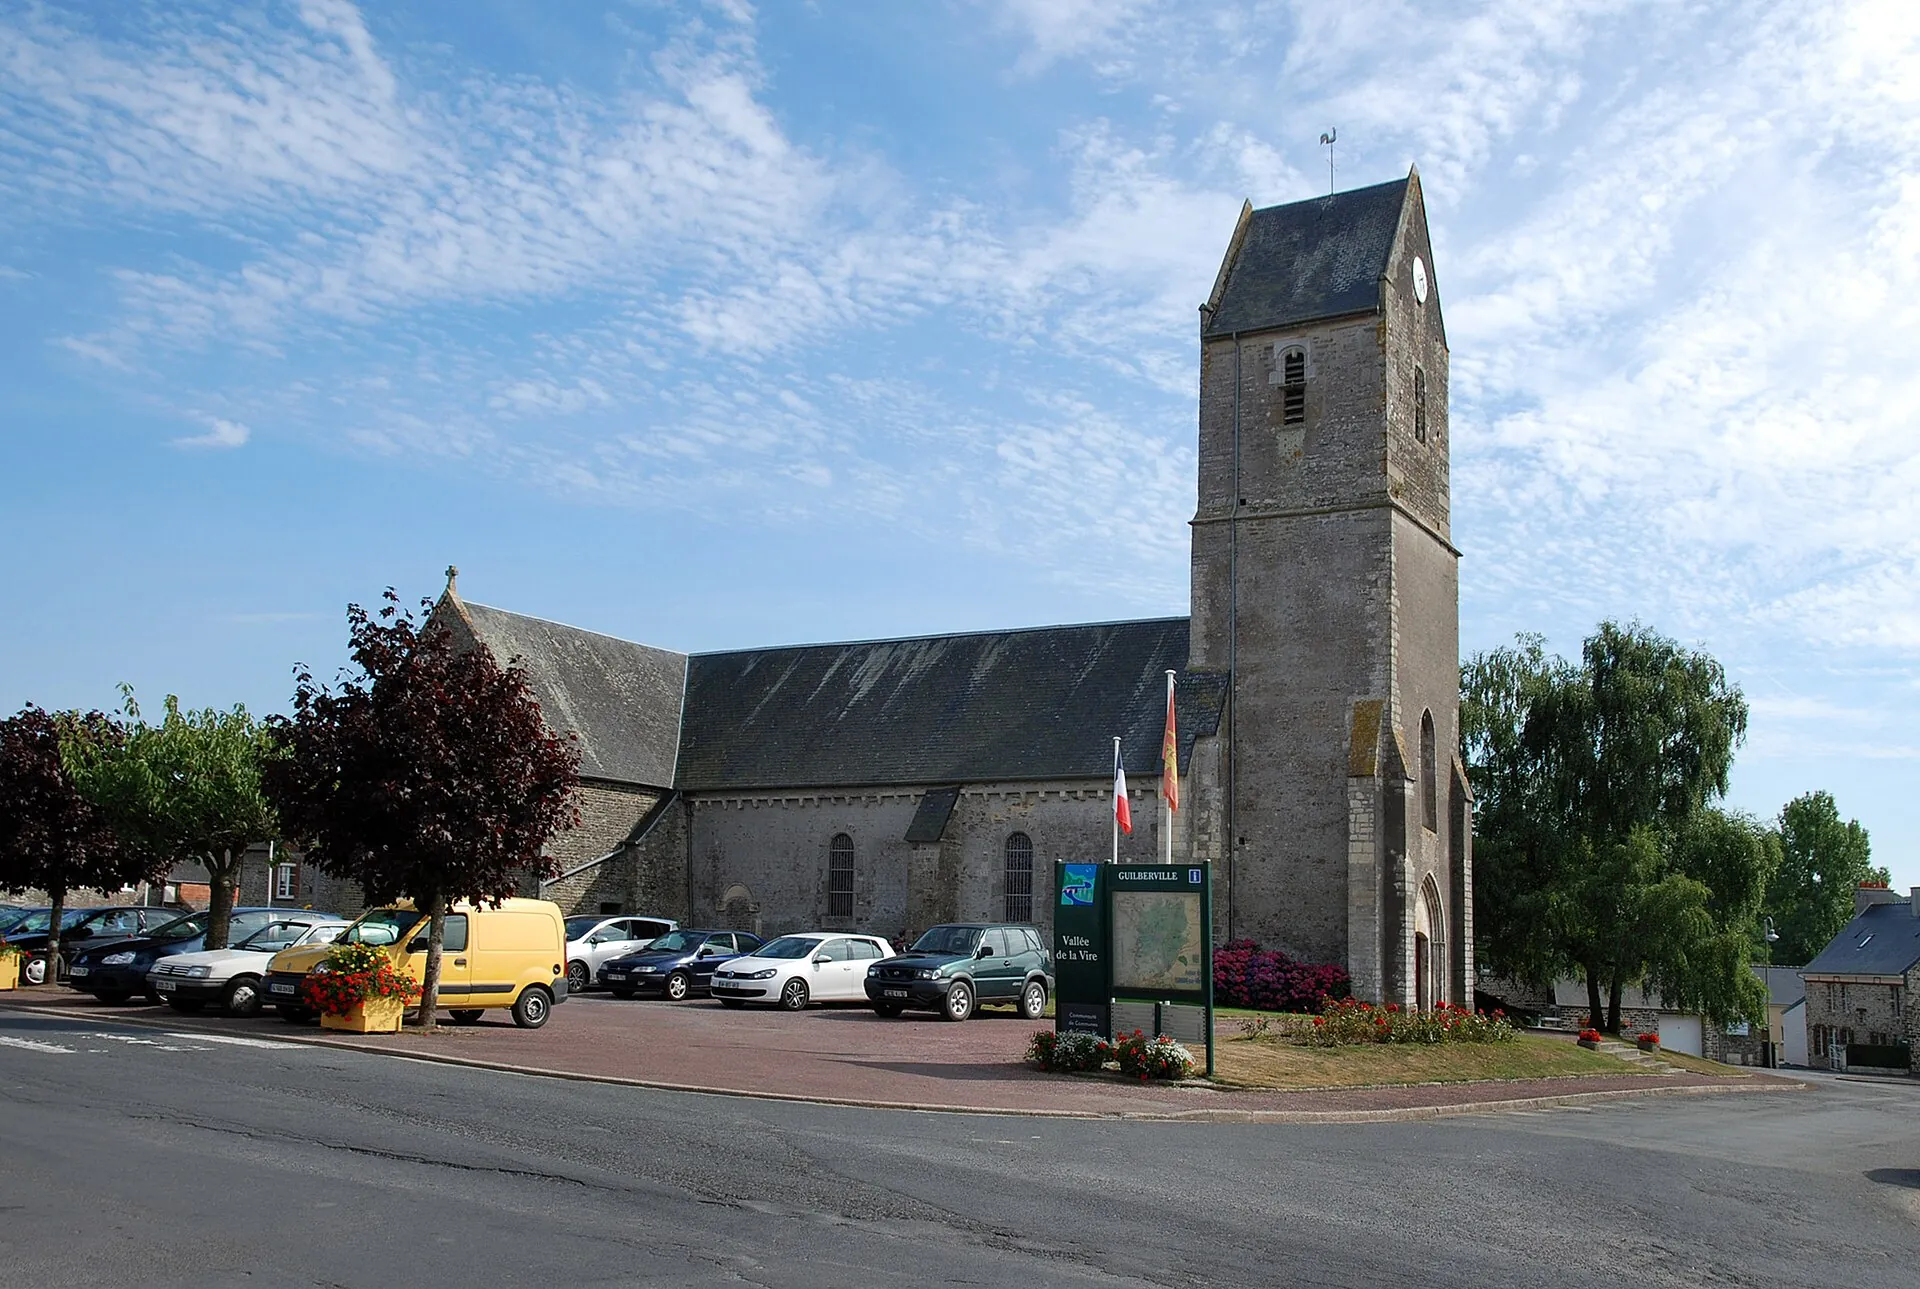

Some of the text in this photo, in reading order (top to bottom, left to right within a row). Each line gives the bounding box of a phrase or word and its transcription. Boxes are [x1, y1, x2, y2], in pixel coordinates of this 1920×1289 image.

[1118, 871, 1178, 881] GUILBERVILLE
[1062, 935, 1090, 947] Vallée
[1056, 949, 1098, 961] de la Vire
